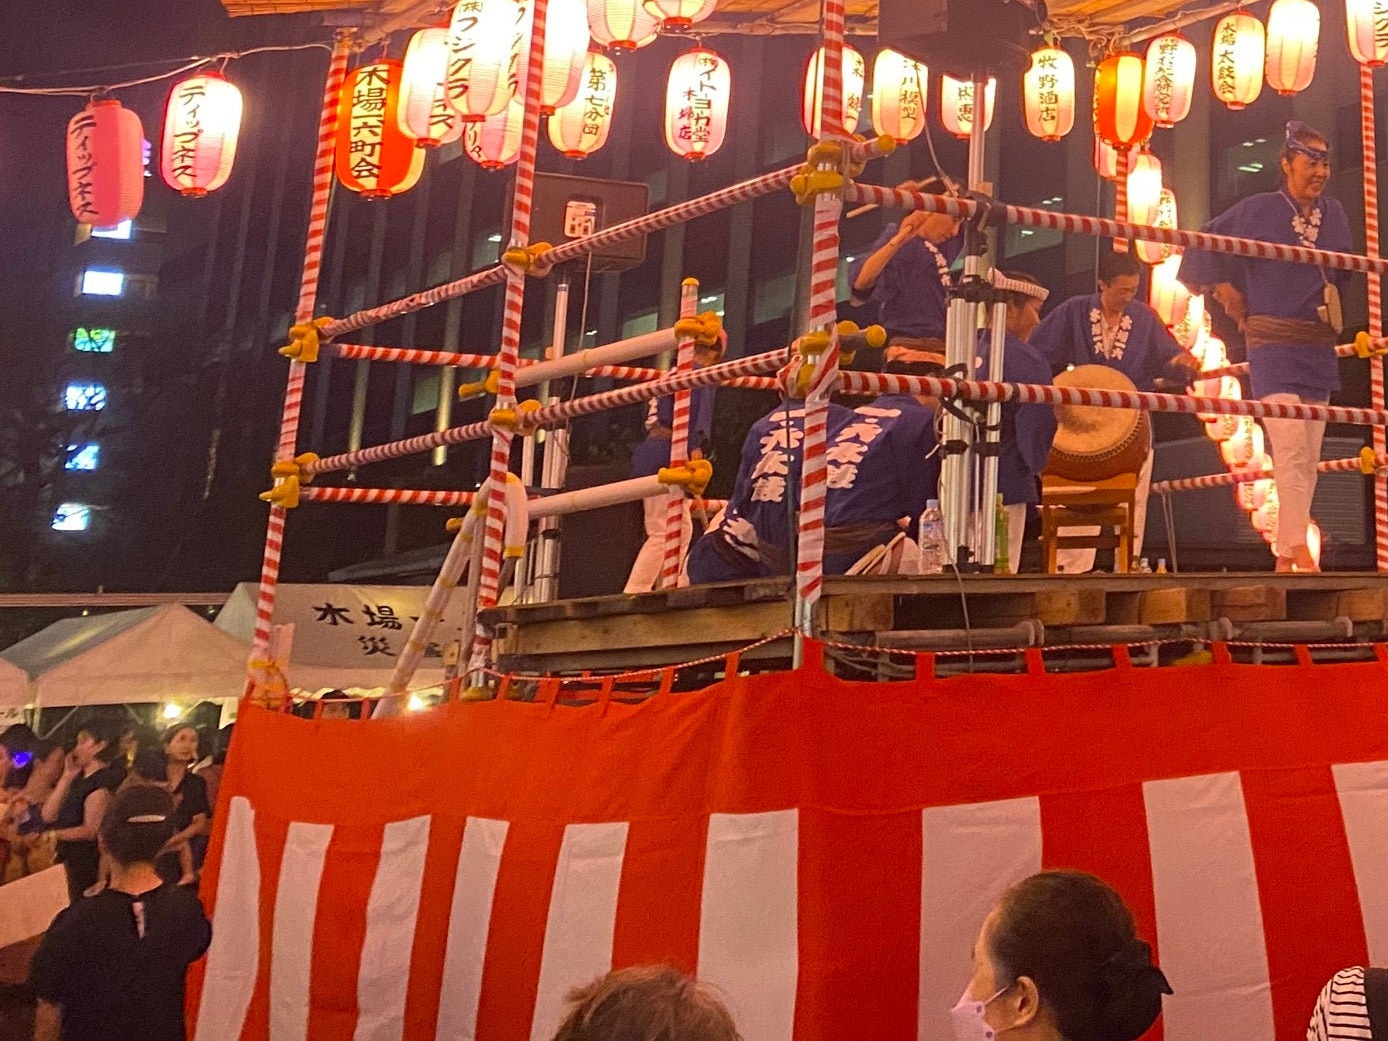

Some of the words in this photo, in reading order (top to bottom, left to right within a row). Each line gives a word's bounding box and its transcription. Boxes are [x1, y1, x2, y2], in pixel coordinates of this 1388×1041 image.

[172, 85, 206, 180] ティップネス
